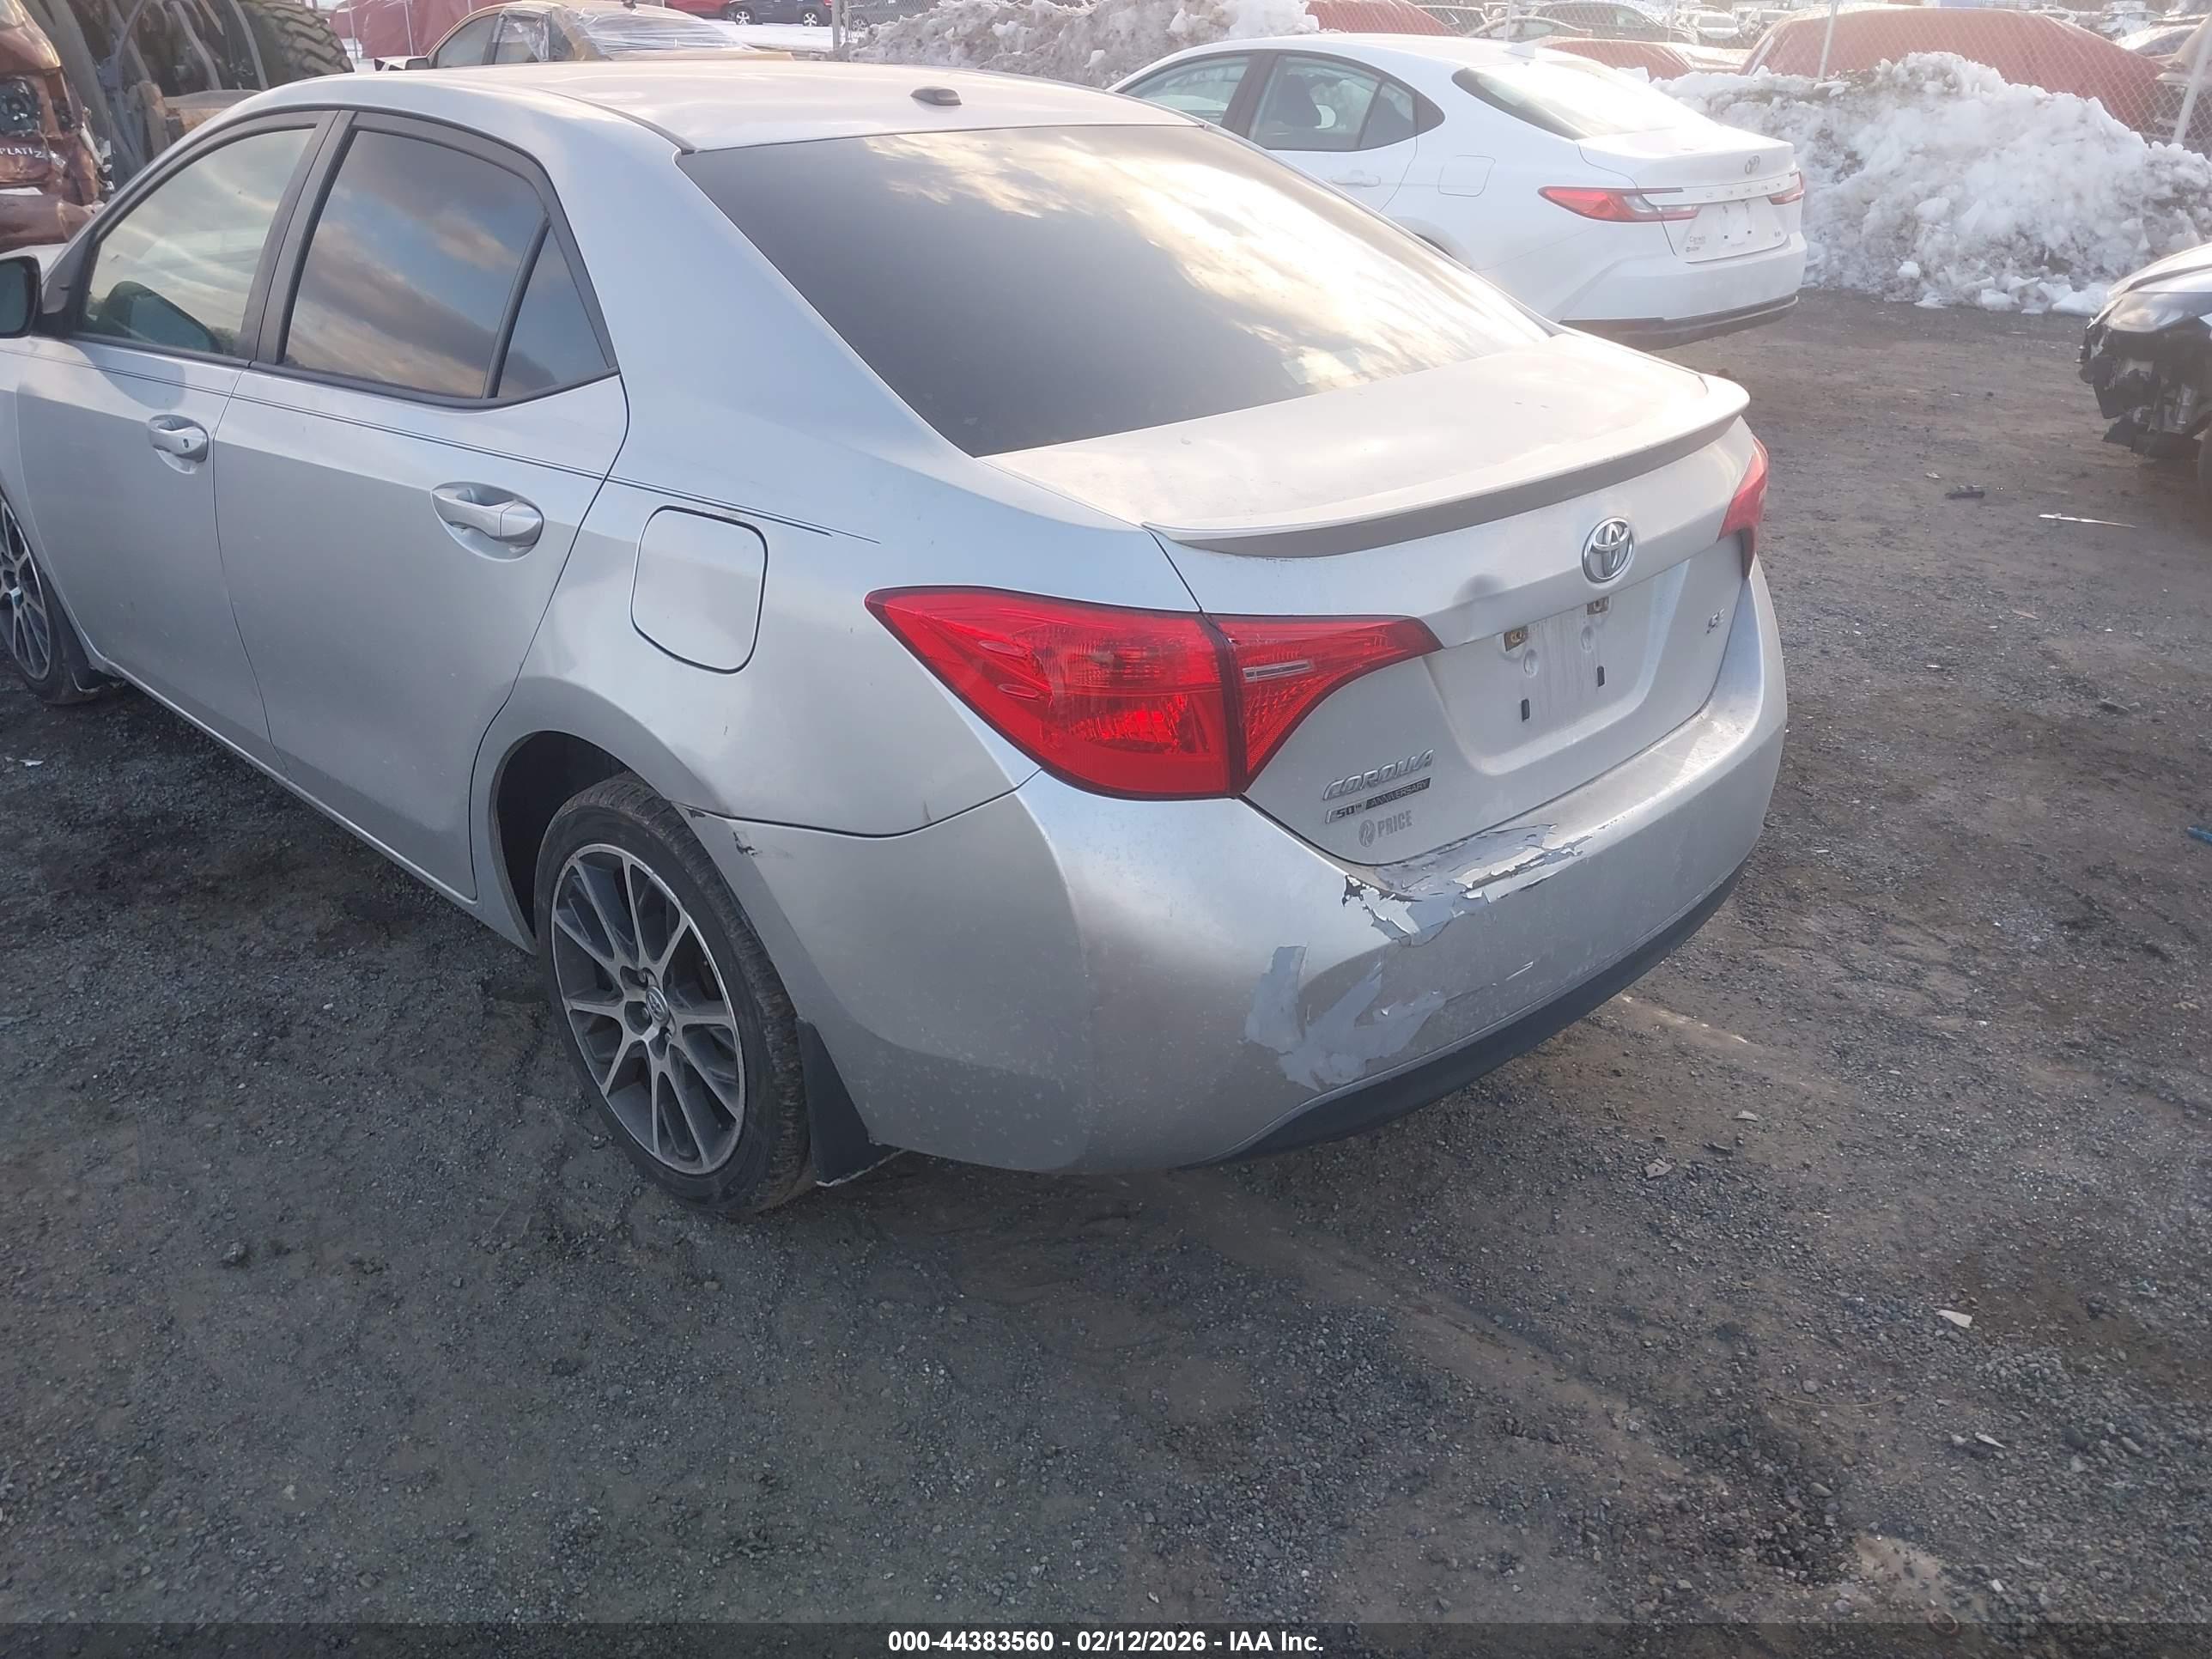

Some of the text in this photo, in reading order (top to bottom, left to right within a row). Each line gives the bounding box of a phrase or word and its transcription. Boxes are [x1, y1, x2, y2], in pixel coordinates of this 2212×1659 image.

[1322, 749, 1436, 800] COROLLA
[1367, 780, 1429, 807] ANNIVERSARY
[1377, 810, 1413, 836] PRICE
